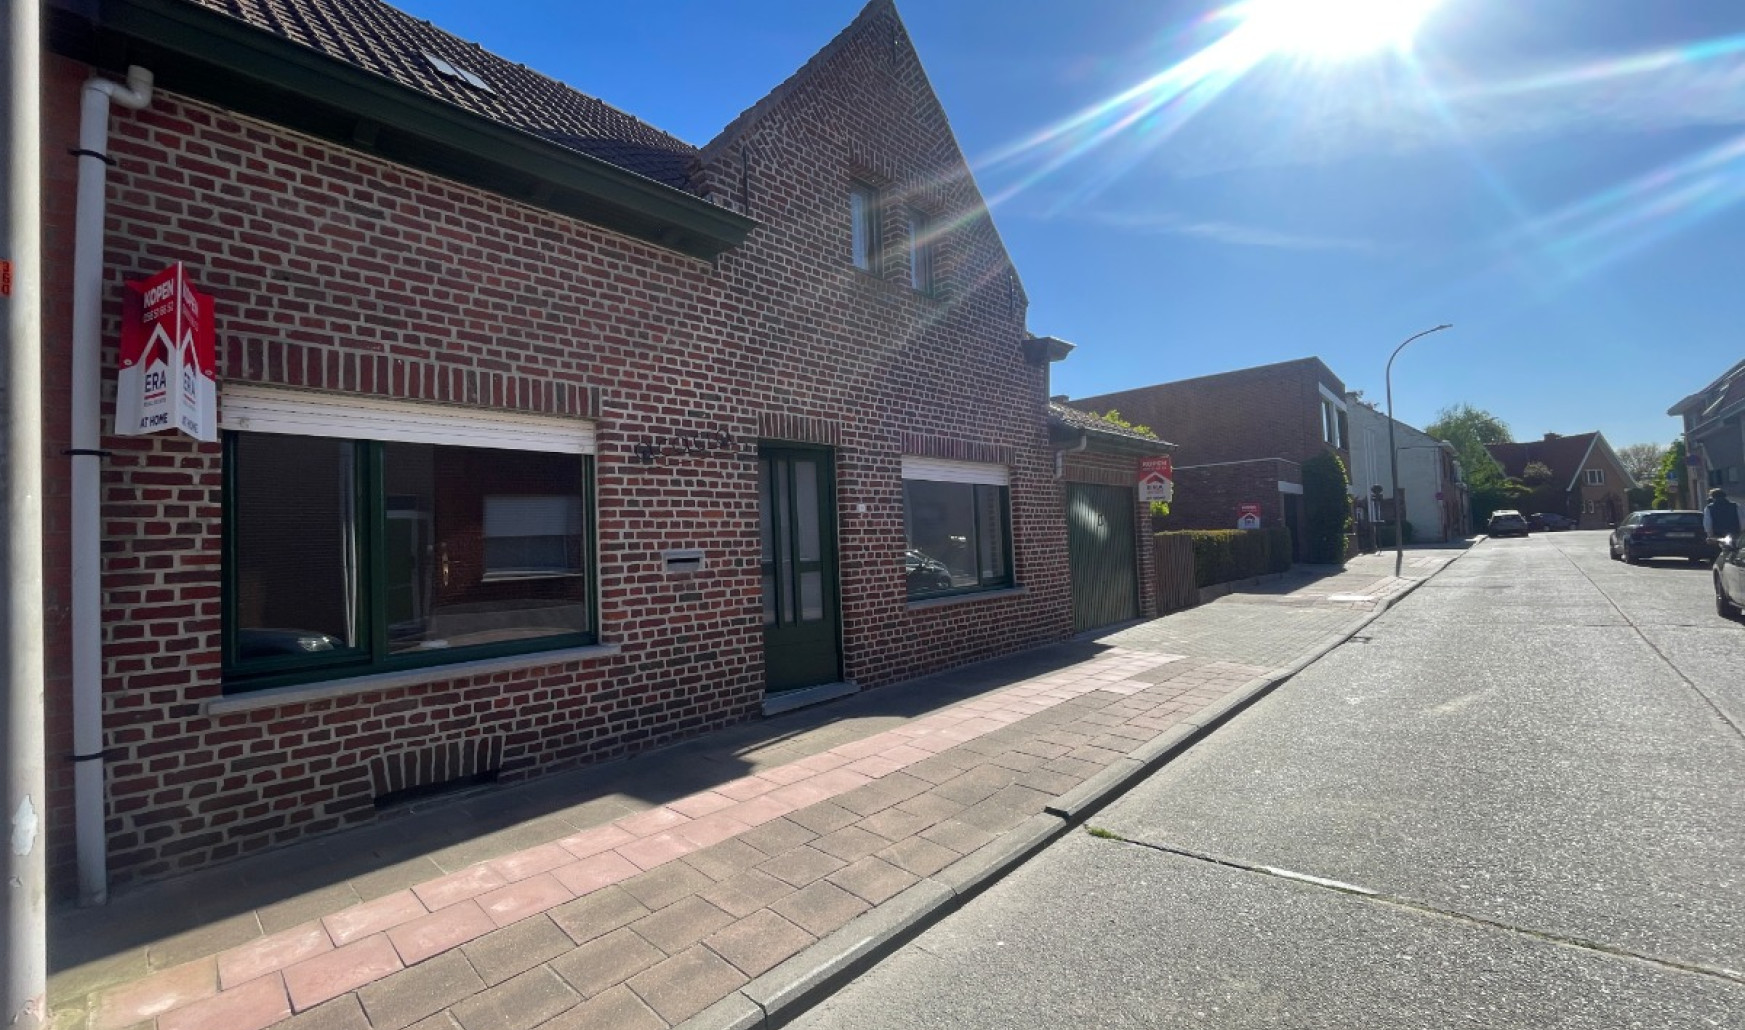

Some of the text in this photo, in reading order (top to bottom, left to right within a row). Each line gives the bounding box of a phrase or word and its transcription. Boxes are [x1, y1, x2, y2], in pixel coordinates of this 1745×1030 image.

[143, 278, 174, 309] KOPEN
[145, 370, 167, 392] ERA
[184, 372, 197, 396] ERA
[140, 412, 168, 428] AT HOME
